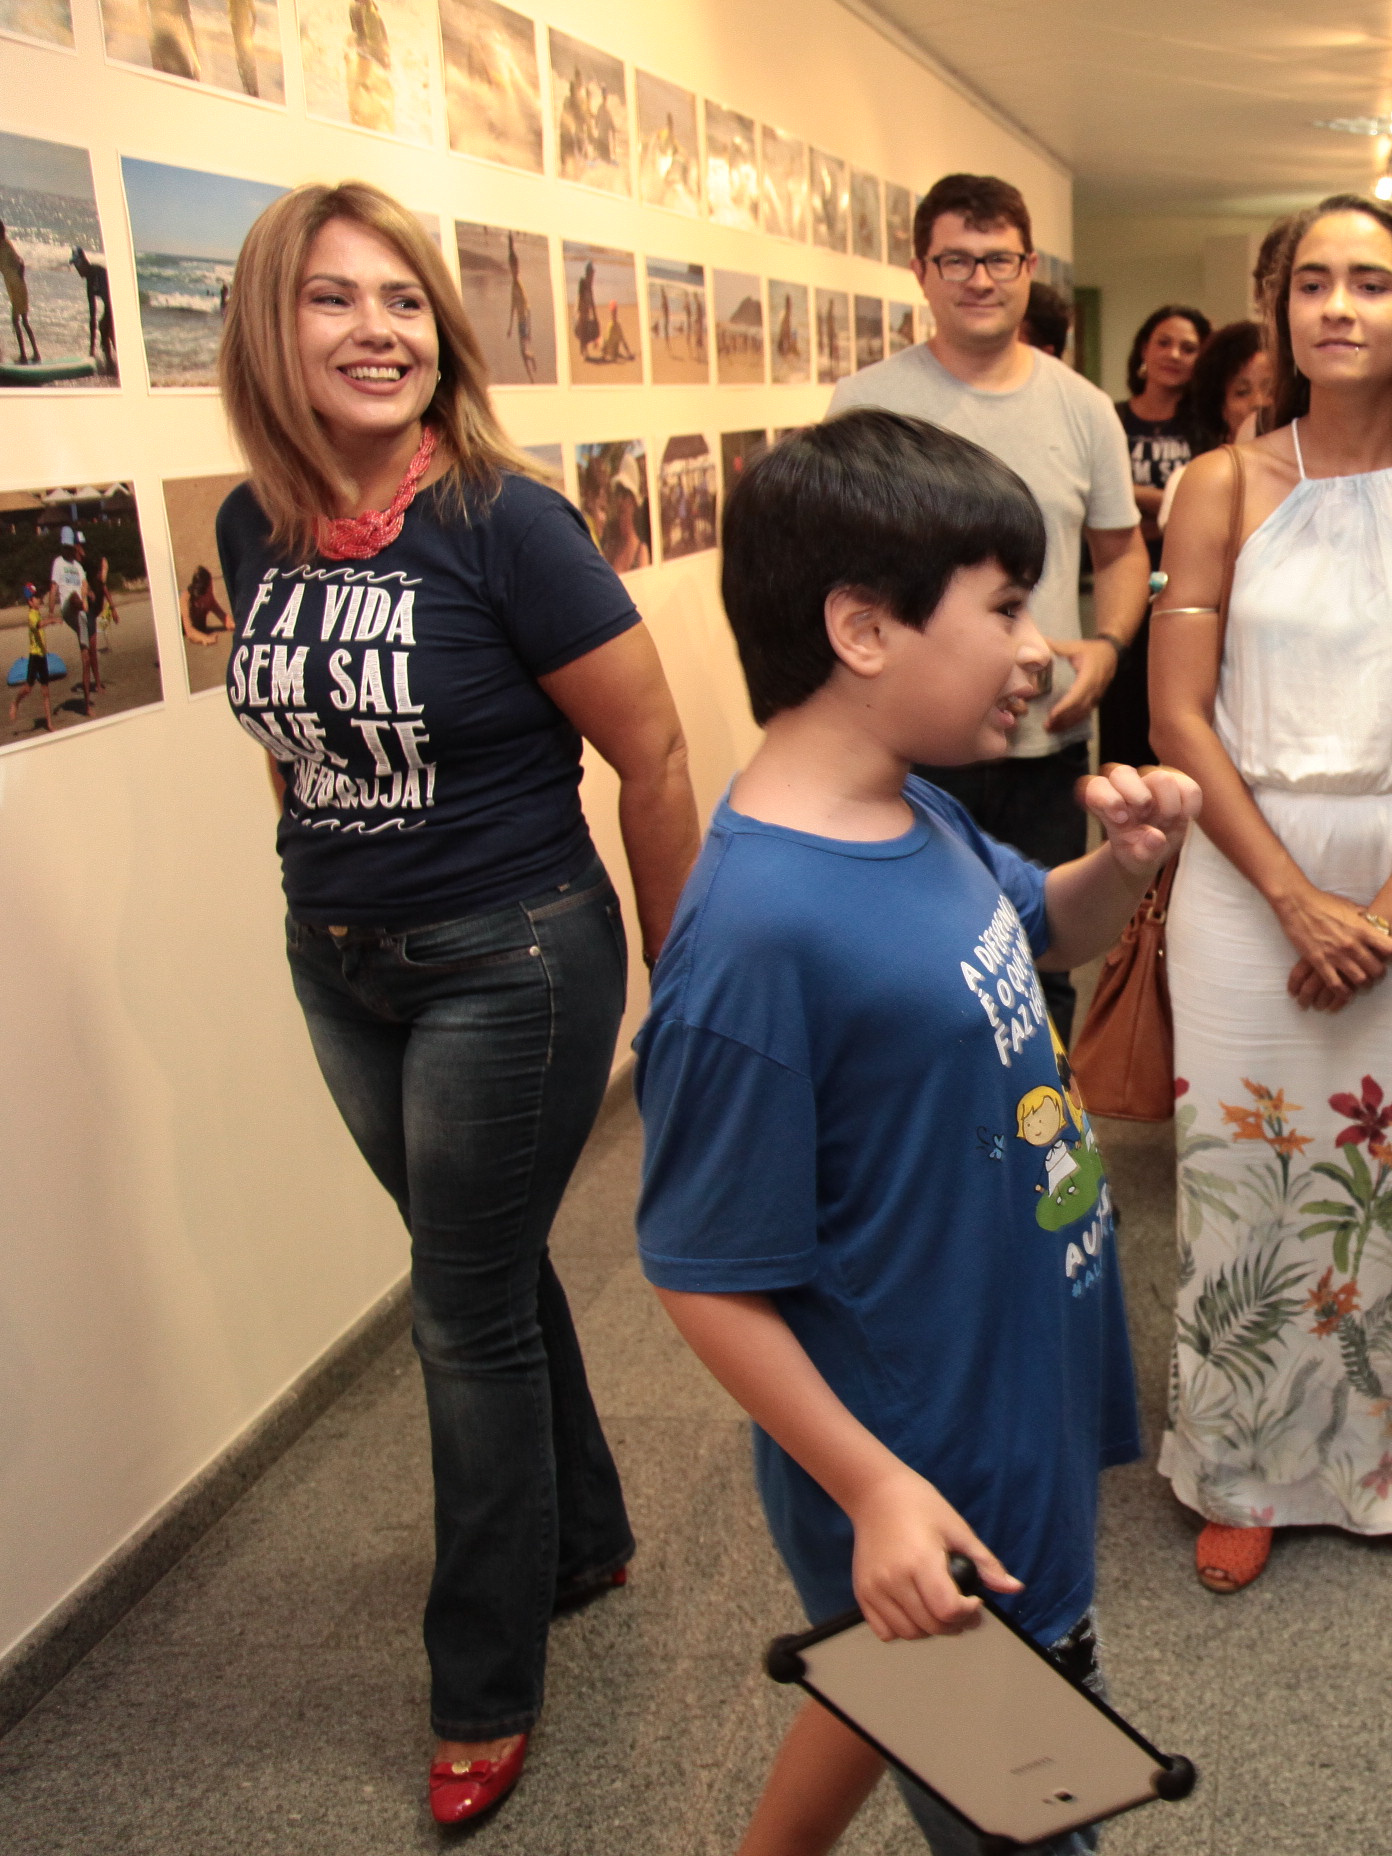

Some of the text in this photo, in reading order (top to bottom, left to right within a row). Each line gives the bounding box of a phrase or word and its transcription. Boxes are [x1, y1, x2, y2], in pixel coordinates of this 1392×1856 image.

[241, 568, 416, 645] É A VIDA
[230, 643, 425, 714] SEM SAL
[240, 711, 438, 777] QUE TE
[960, 960, 986, 994] A
[997, 978, 1015, 1009] O
[994, 1003, 1037, 1069] FAZ
